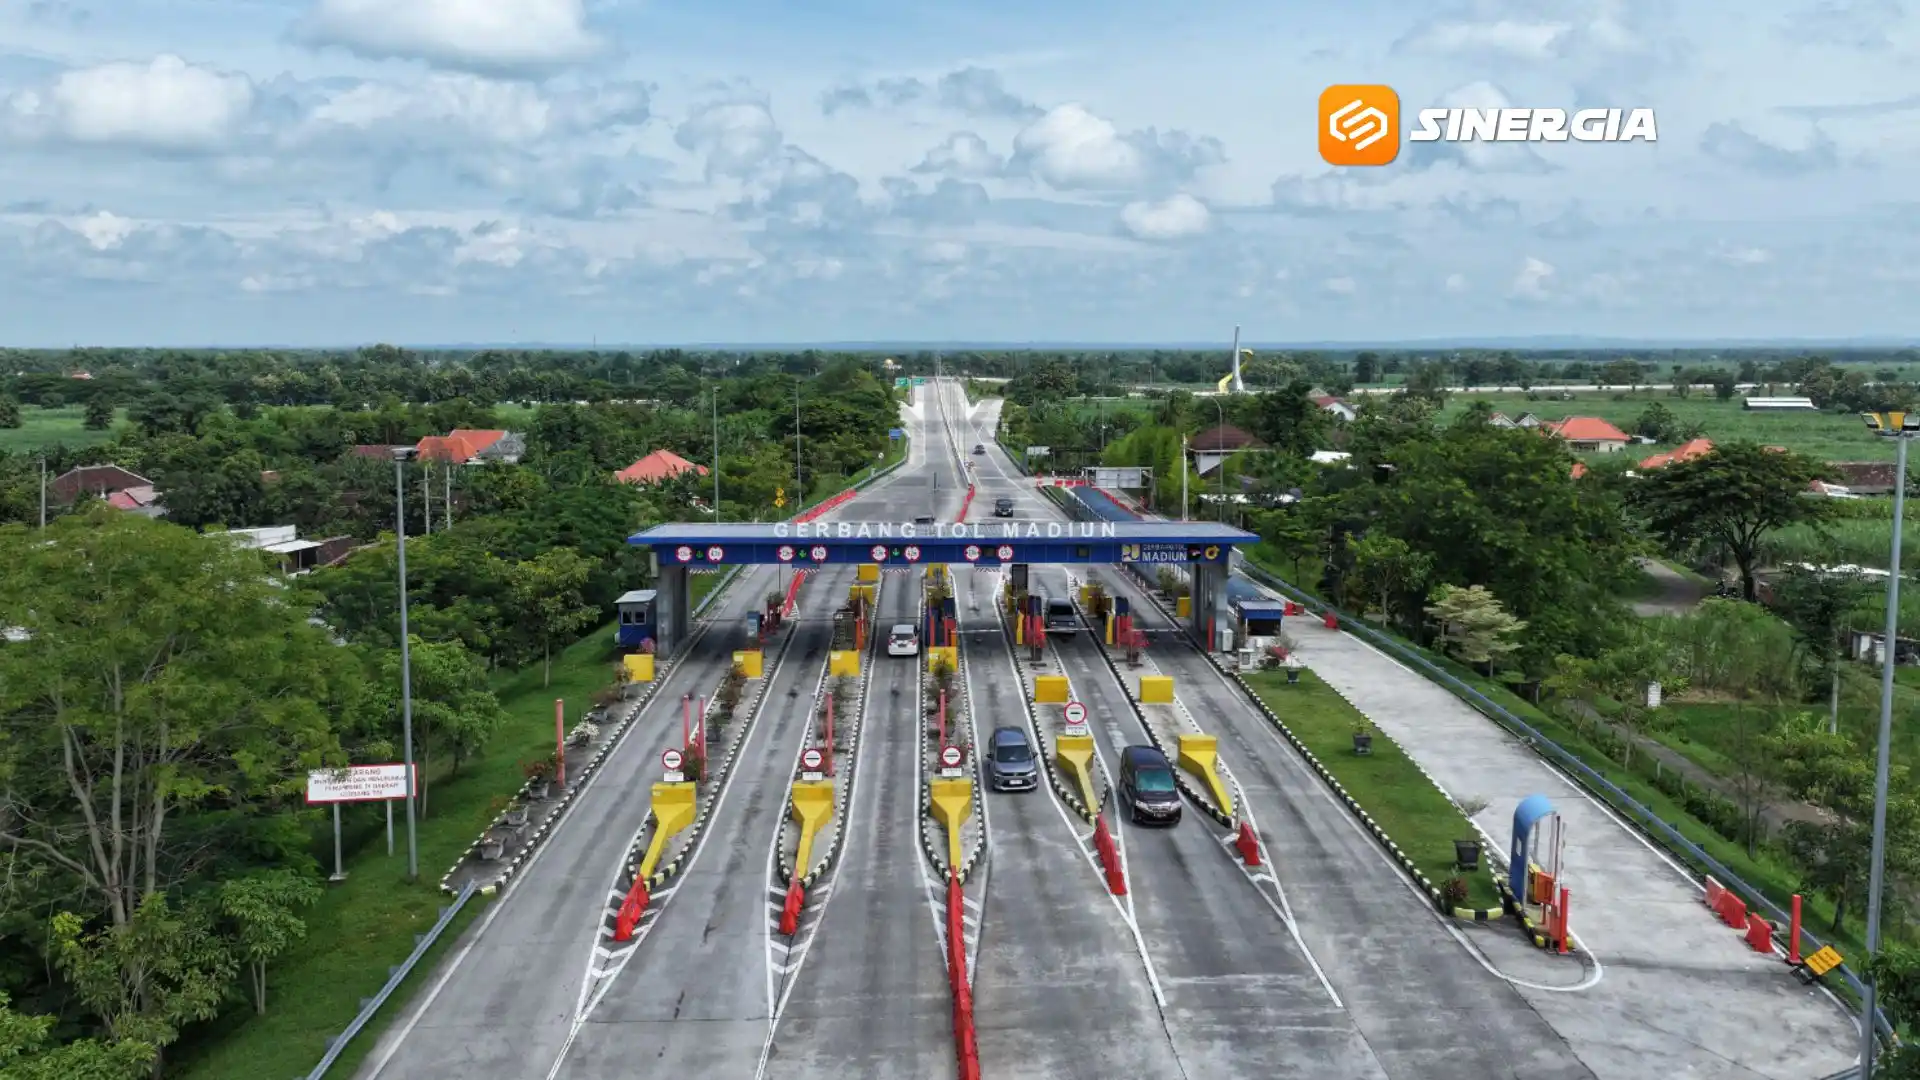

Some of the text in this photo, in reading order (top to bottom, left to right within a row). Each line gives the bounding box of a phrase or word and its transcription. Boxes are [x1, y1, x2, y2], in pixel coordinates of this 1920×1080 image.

[773, 522, 1115, 538] GERBANG TOL MADIUN
[1142, 551, 1187, 561] MADIUN
